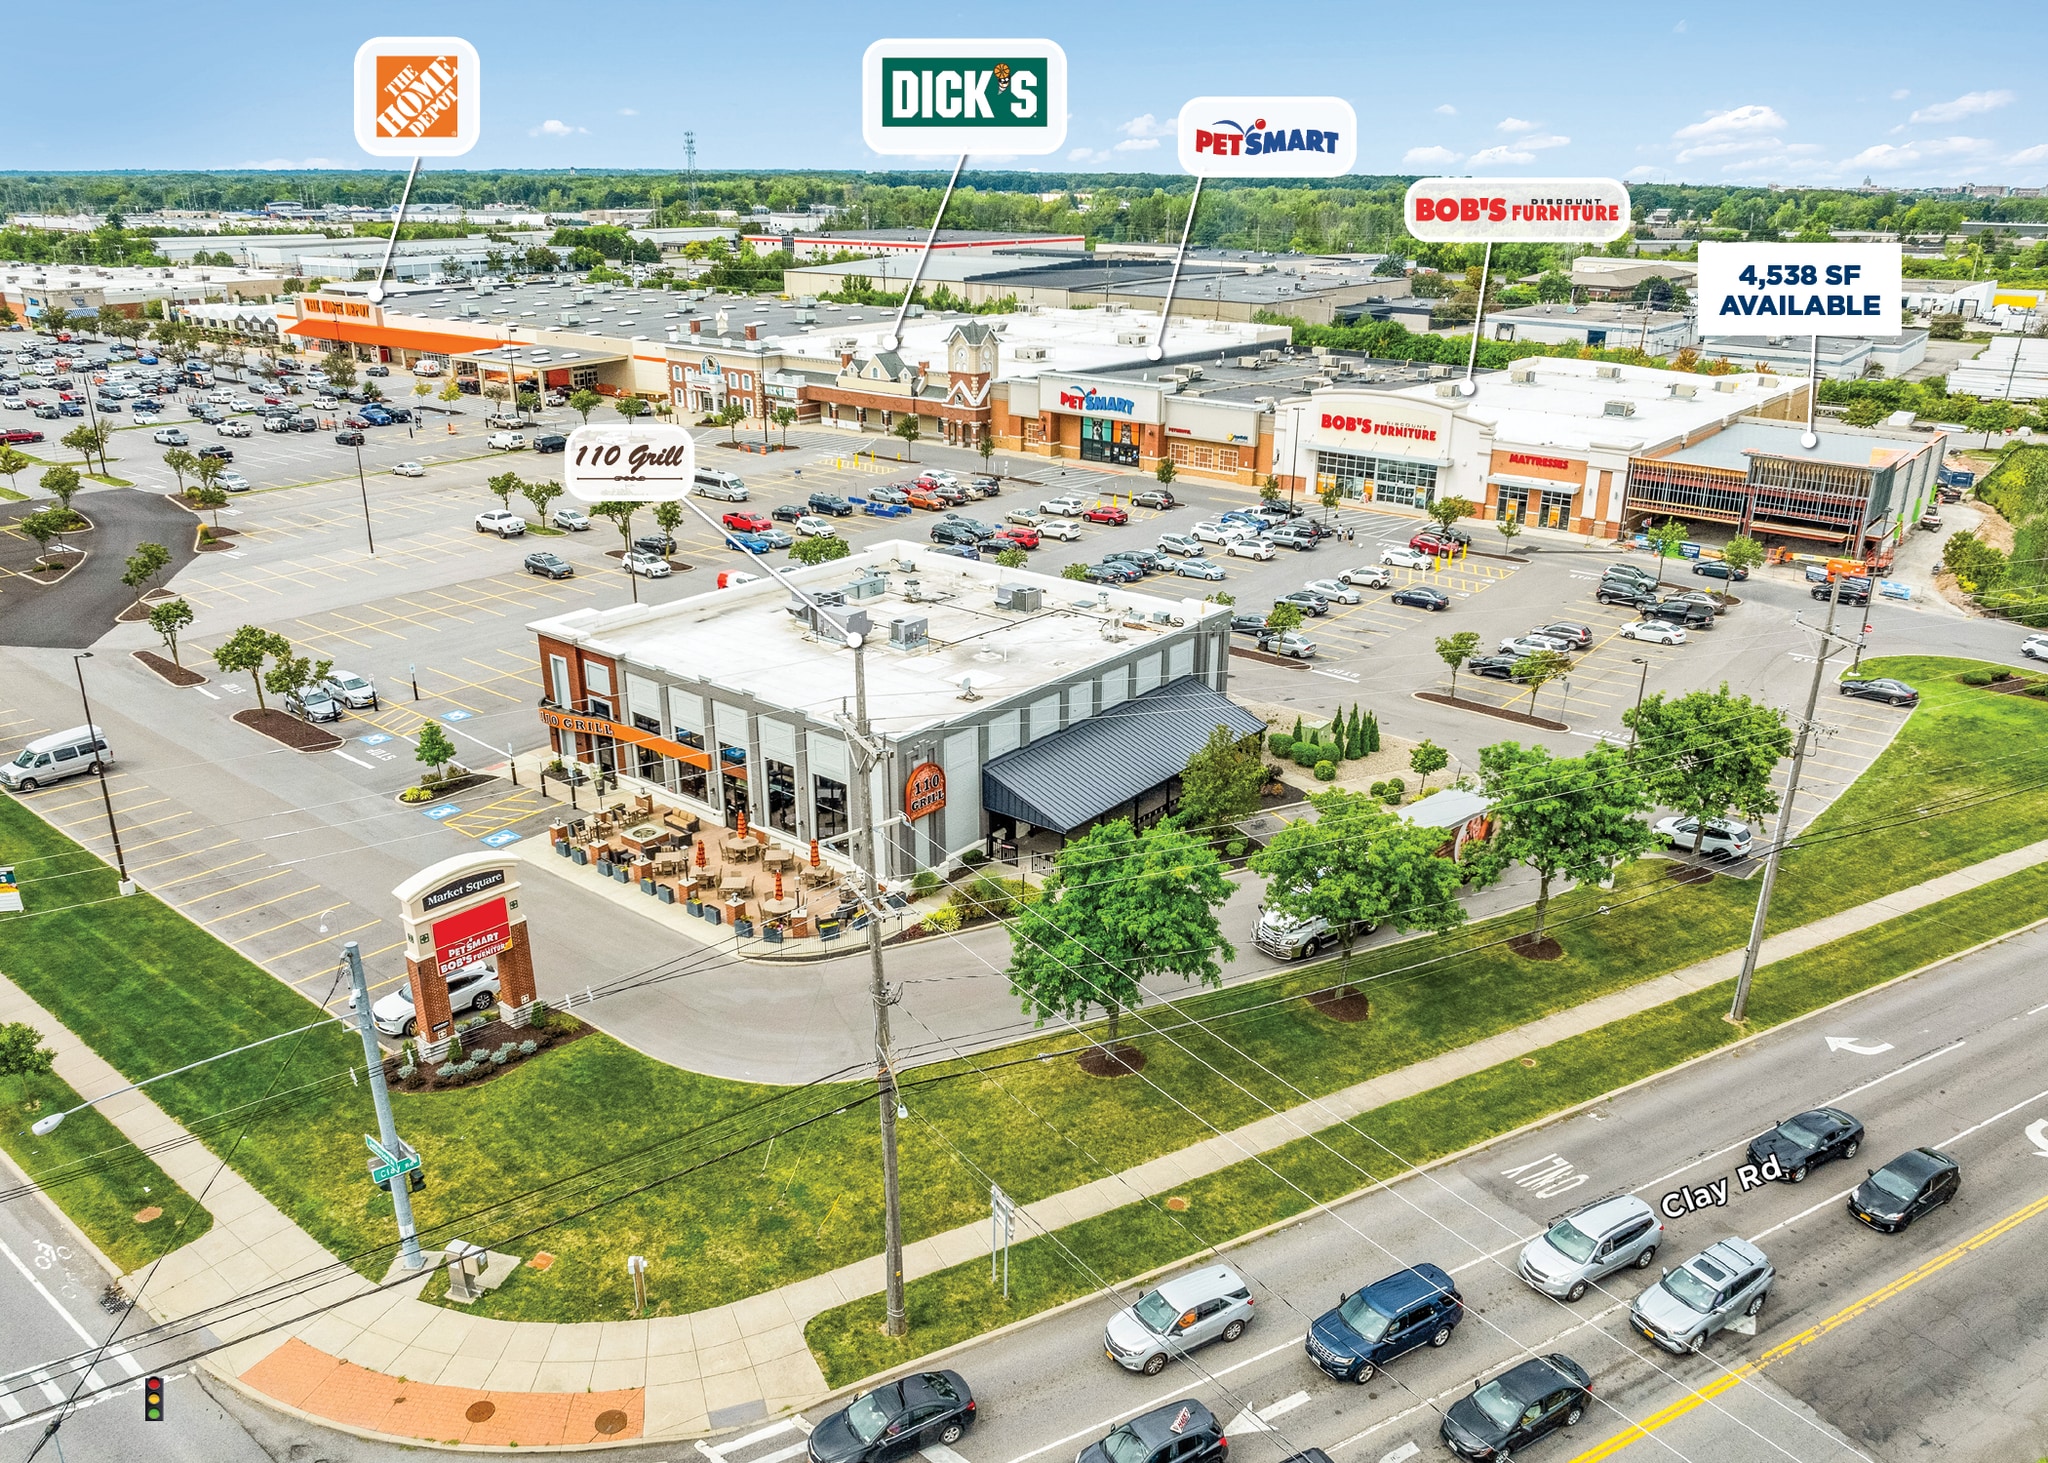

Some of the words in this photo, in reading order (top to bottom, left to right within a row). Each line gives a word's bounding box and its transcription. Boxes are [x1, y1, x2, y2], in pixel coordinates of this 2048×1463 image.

[304, 298, 321, 313] THE
[1321, 413, 1372, 434] BOB'S
[1374, 424, 1437, 442] FURNITURE
[1509, 453, 1569, 470] MATTRESSES
[563, 717, 614, 736] GRILL
[914, 774, 940, 796] 110
[911, 790, 945, 812] GRILL
[427, 886, 464, 906] Market
[466, 872, 502, 892] Square
[440, 954, 473, 975] BOB'S
[473, 942, 507, 961] FURNITUR
[1501, 1153, 1590, 1200] ONLY
